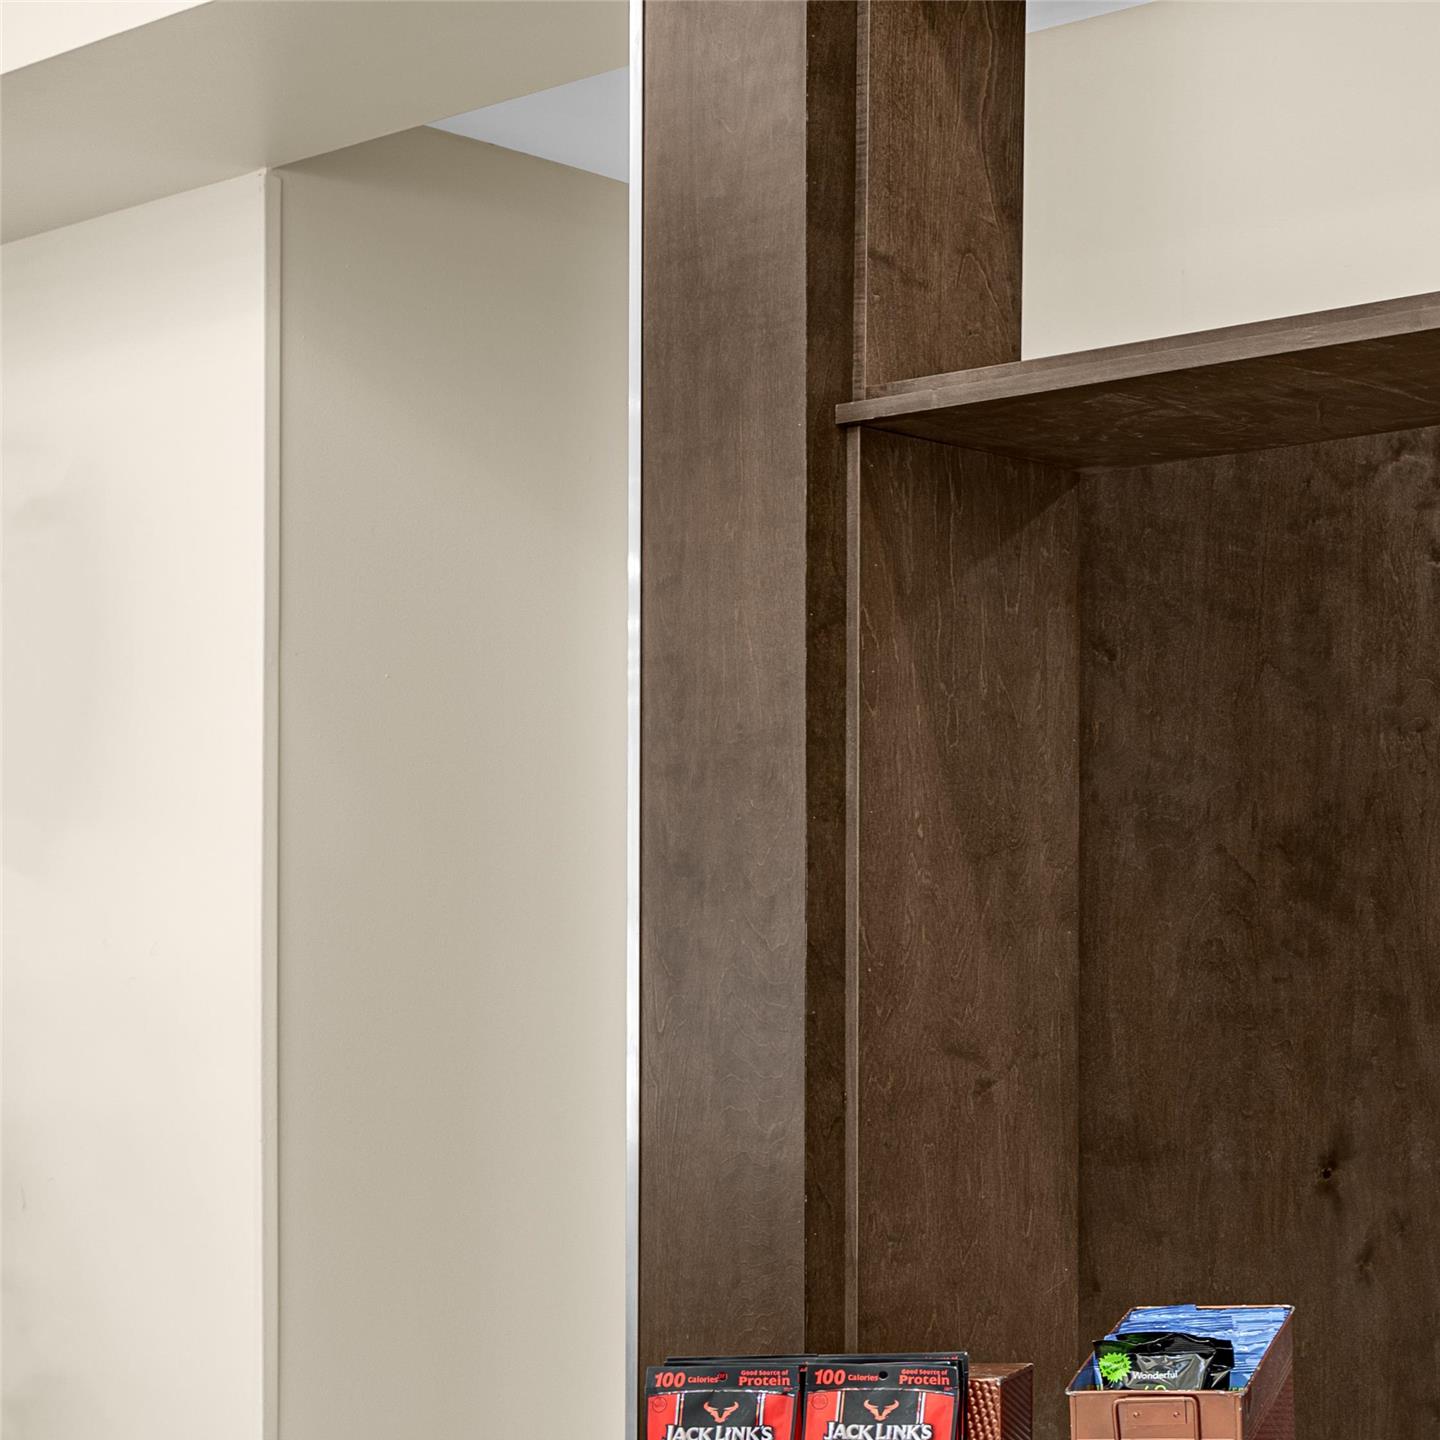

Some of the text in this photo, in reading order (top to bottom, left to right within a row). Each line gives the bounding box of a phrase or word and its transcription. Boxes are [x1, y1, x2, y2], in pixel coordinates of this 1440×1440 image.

[655, 1372, 686, 1388] 100
[738, 1376, 790, 1385] Protein
[1132, 1371, 1178, 1380] Wonderful
[824, 1422, 932, 1440] JACK LINK'S
